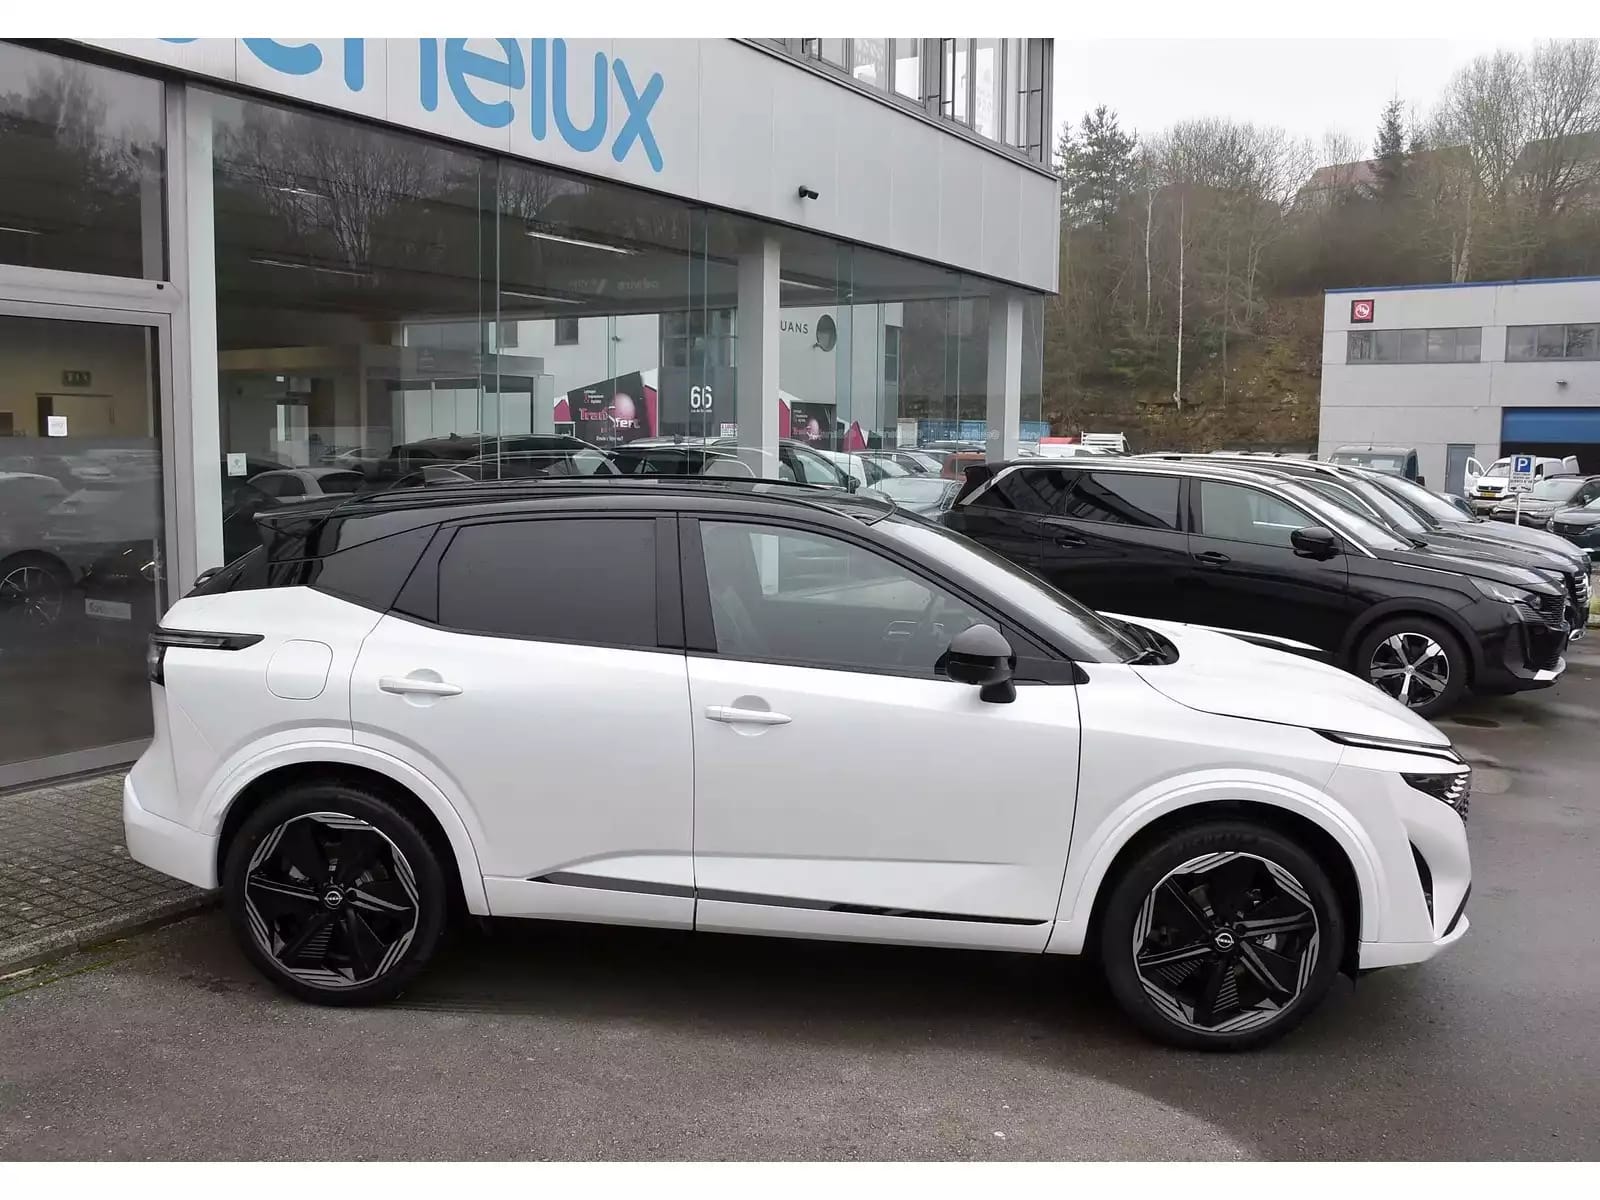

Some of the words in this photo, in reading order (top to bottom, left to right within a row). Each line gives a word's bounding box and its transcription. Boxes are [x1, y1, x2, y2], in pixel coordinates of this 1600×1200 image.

[780, 319, 808, 335] UANS
[690, 385, 712, 409] 66
[1517, 458, 1528, 472] P
